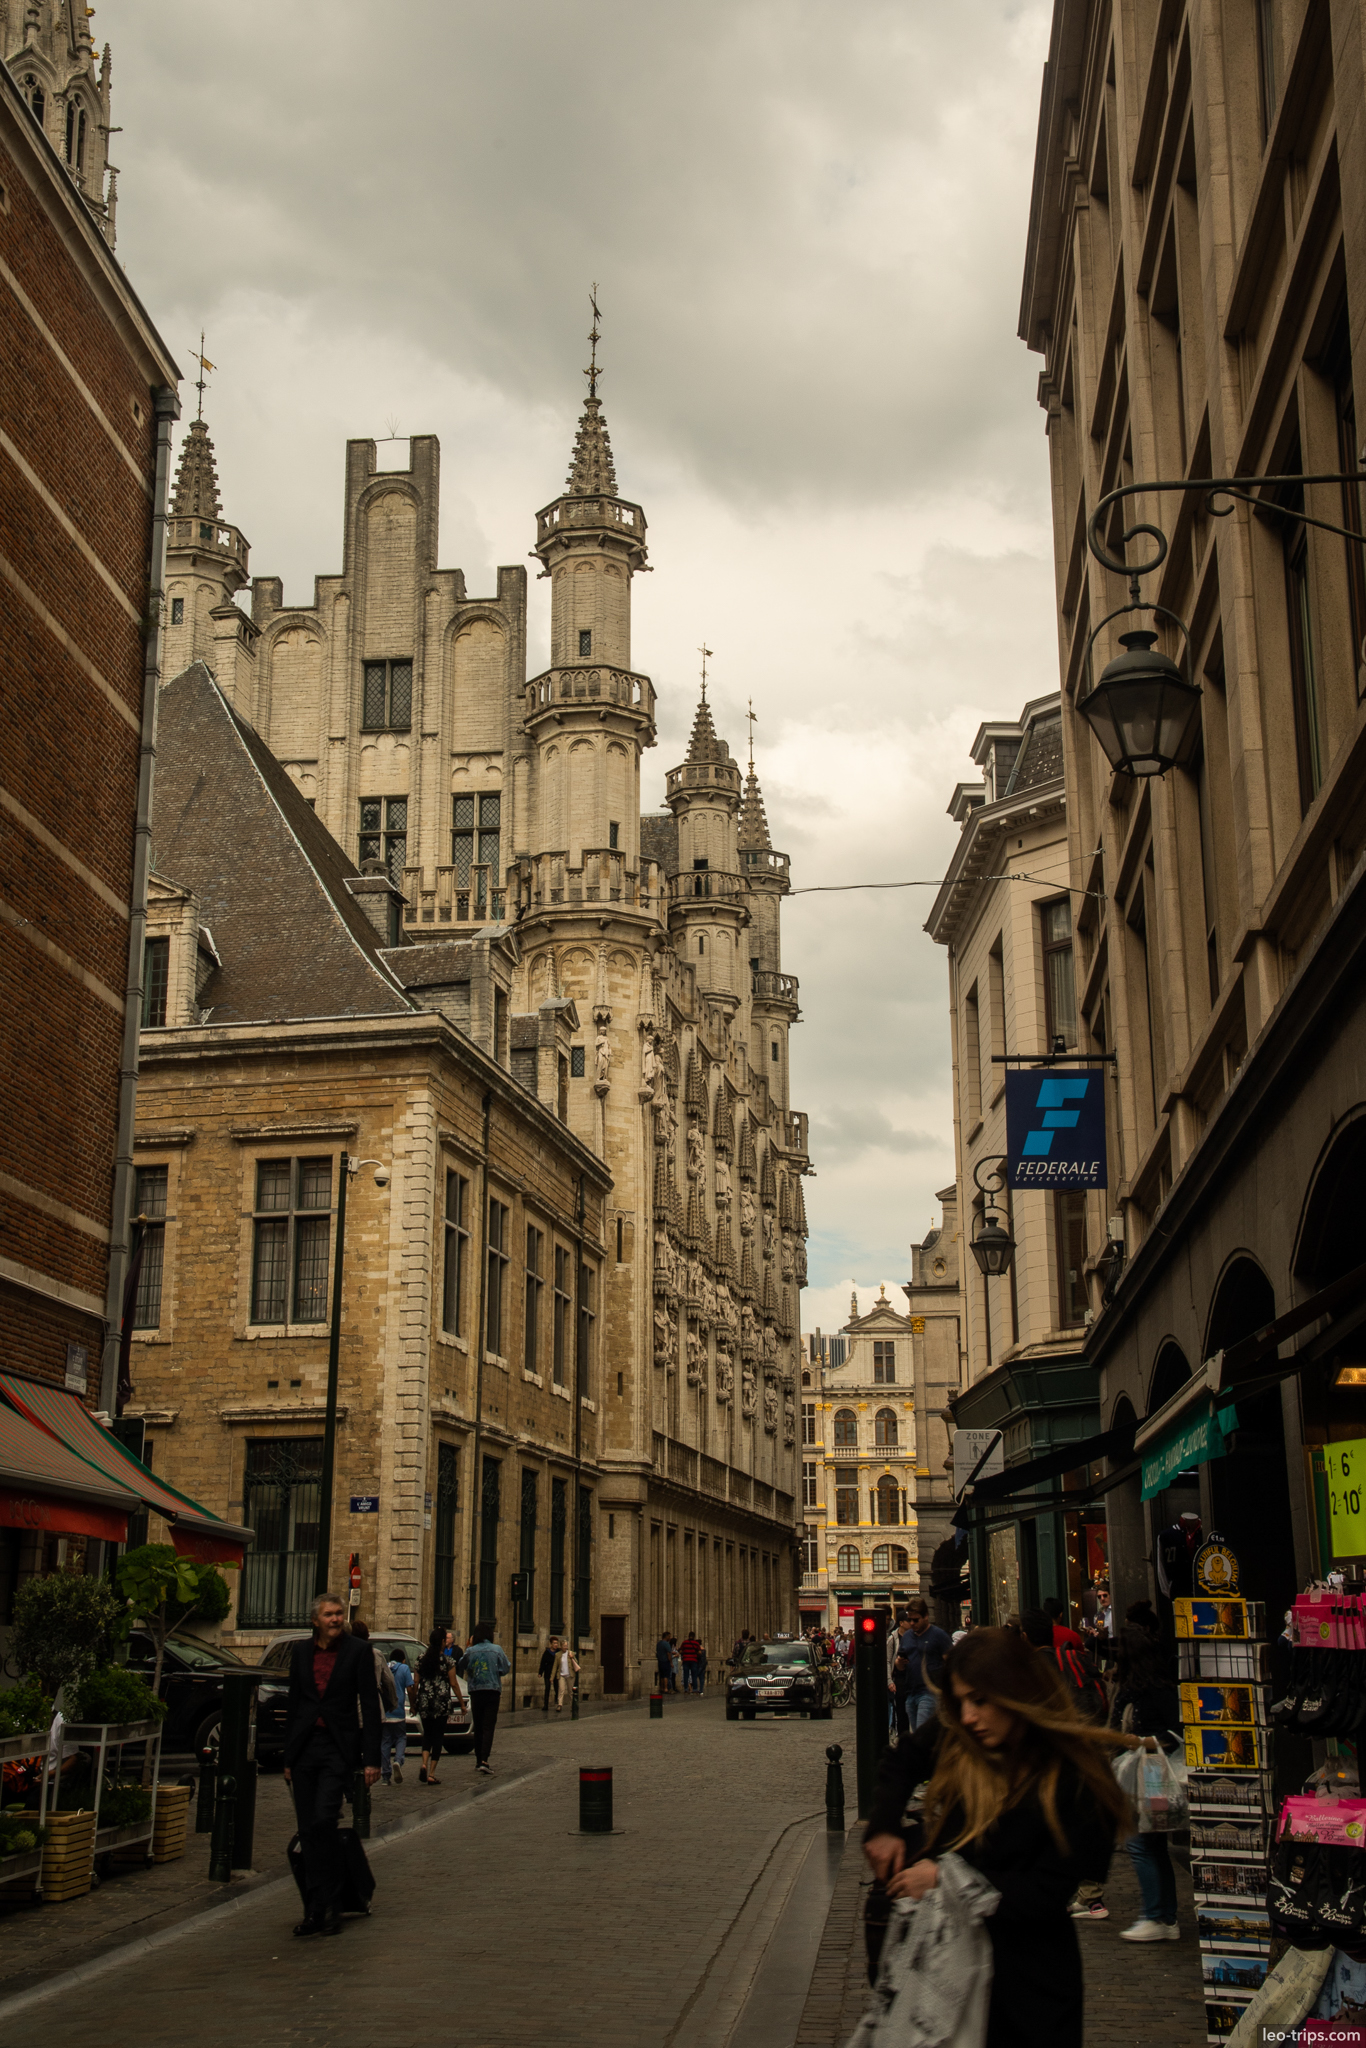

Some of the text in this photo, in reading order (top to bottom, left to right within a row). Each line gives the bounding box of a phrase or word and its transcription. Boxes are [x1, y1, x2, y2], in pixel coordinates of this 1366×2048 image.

[1016, 1161, 1100, 1175] FEDERALE
[966, 1432, 990, 1440] ZONE
[1165, 1547, 1176, 1563] 27
[1197, 1546, 1238, 1582] BEAUTIFUL BELGIUM
